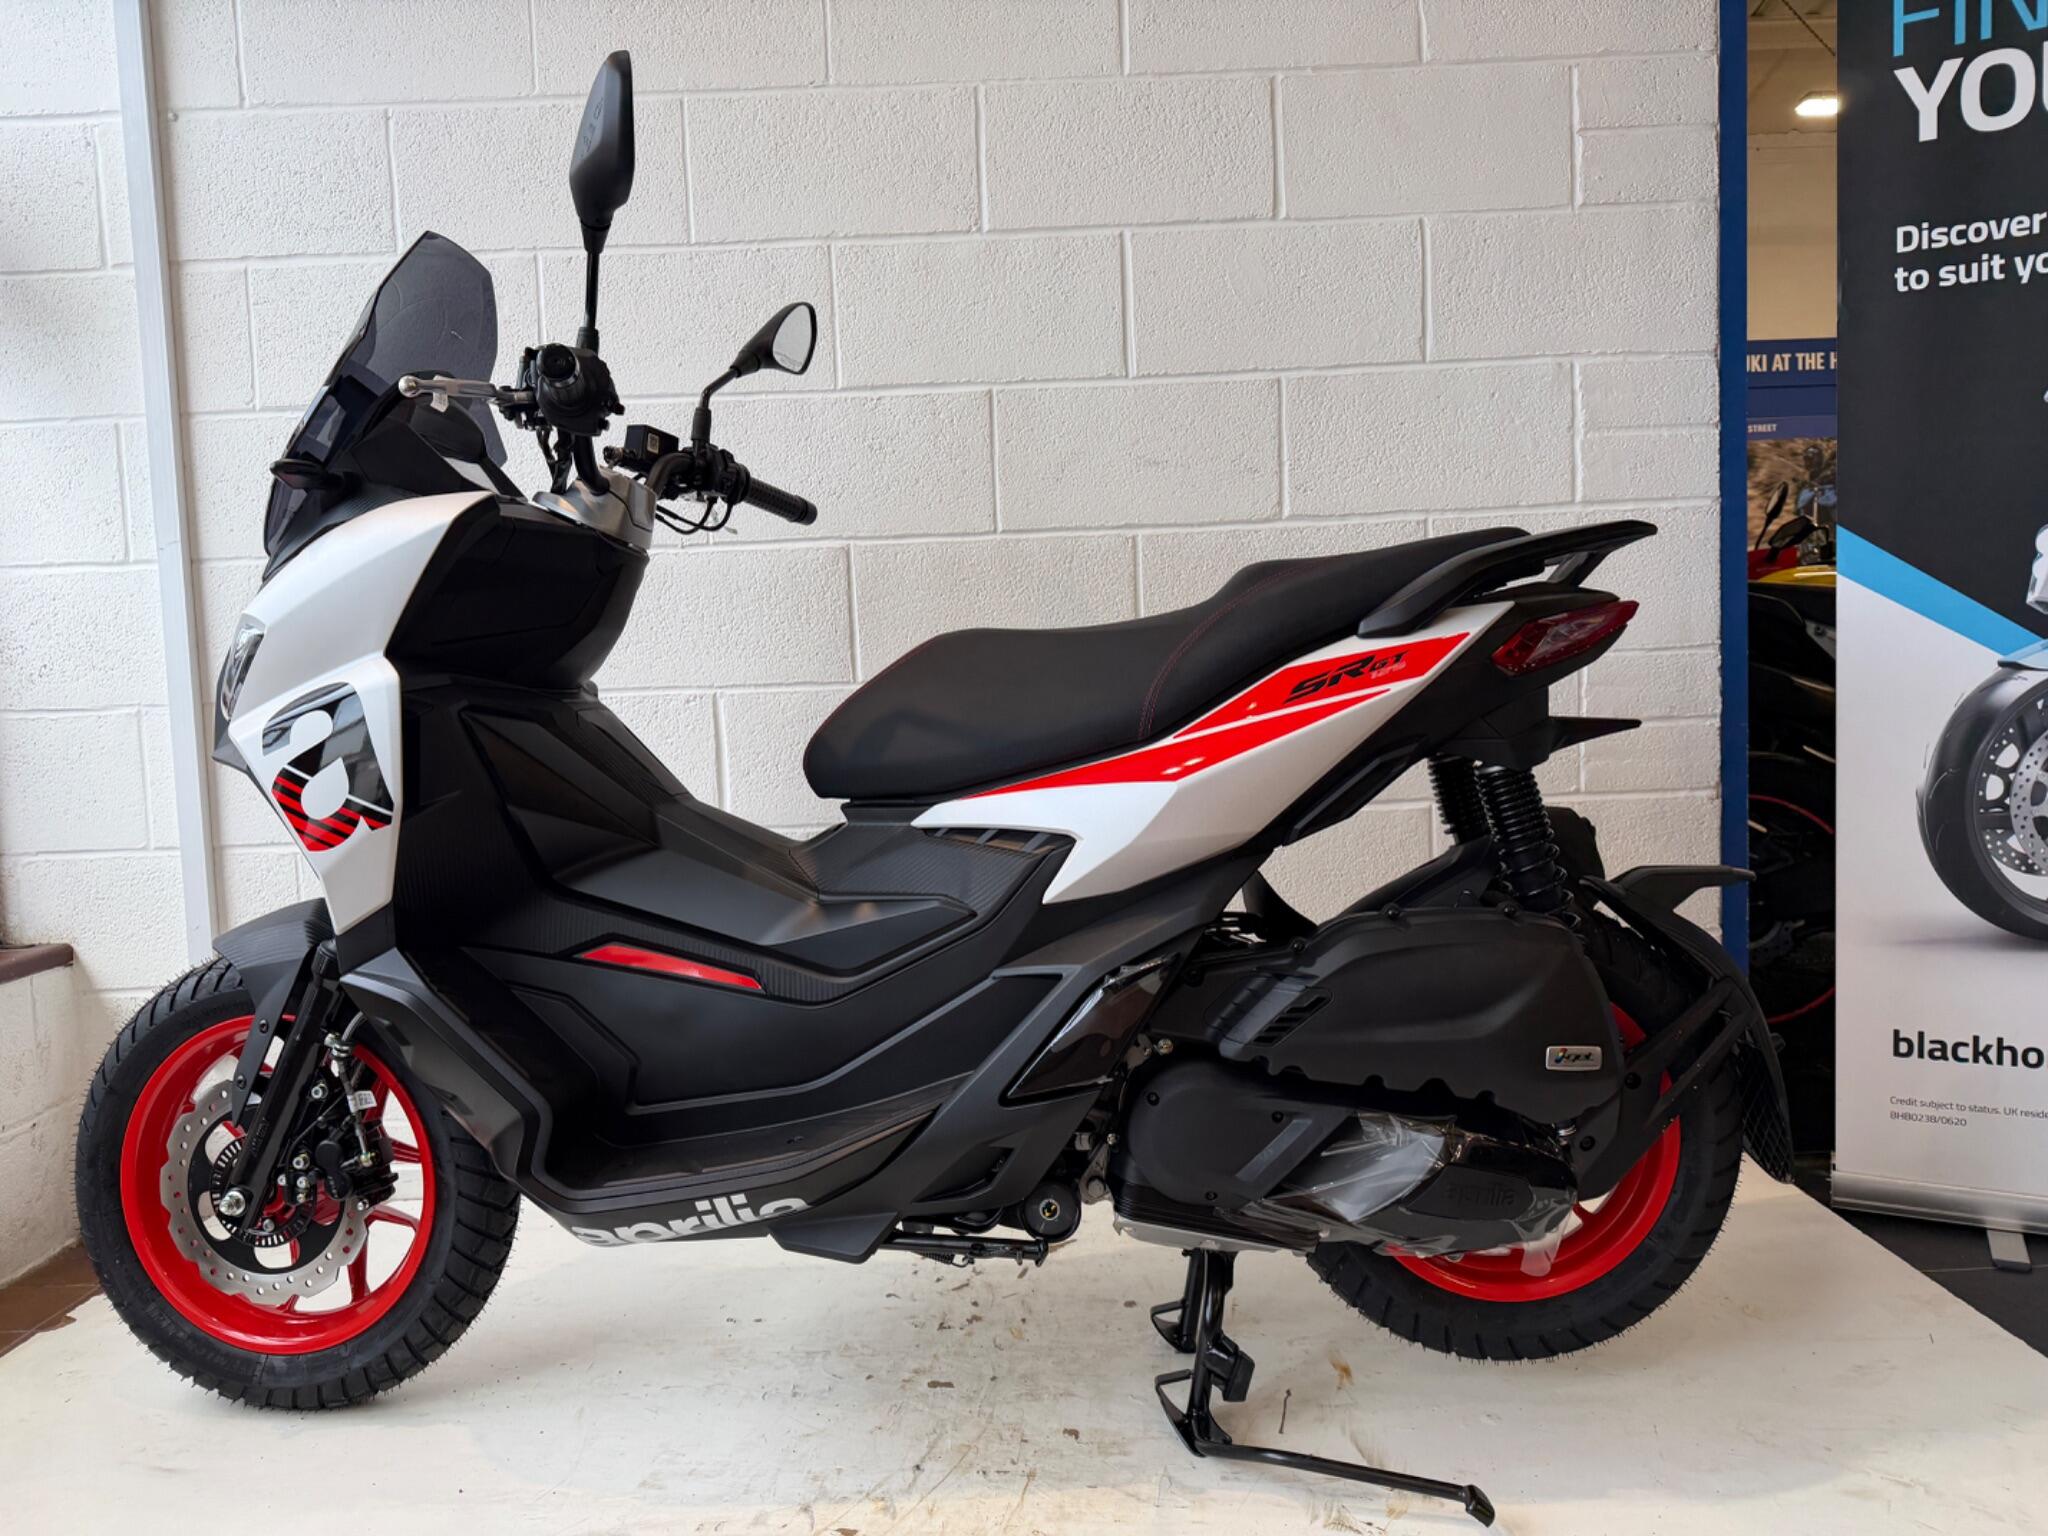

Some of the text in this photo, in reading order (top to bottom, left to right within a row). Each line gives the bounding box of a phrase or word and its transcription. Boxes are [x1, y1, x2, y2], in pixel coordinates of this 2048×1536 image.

[1893, 40, 2048, 143] YO
[1896, 211, 2047, 253] Discover
[1894, 267, 1930, 292] to
[1939, 253, 2006, 287] suit
[1771, 353, 1792, 372] AT
[1795, 352, 1825, 371] THE
[1890, 1095, 1918, 1107] Credit
[1920, 1100, 1954, 1111] subject
[1956, 1103, 1967, 1112] to
[2003, 1106, 2018, 1116] UK
